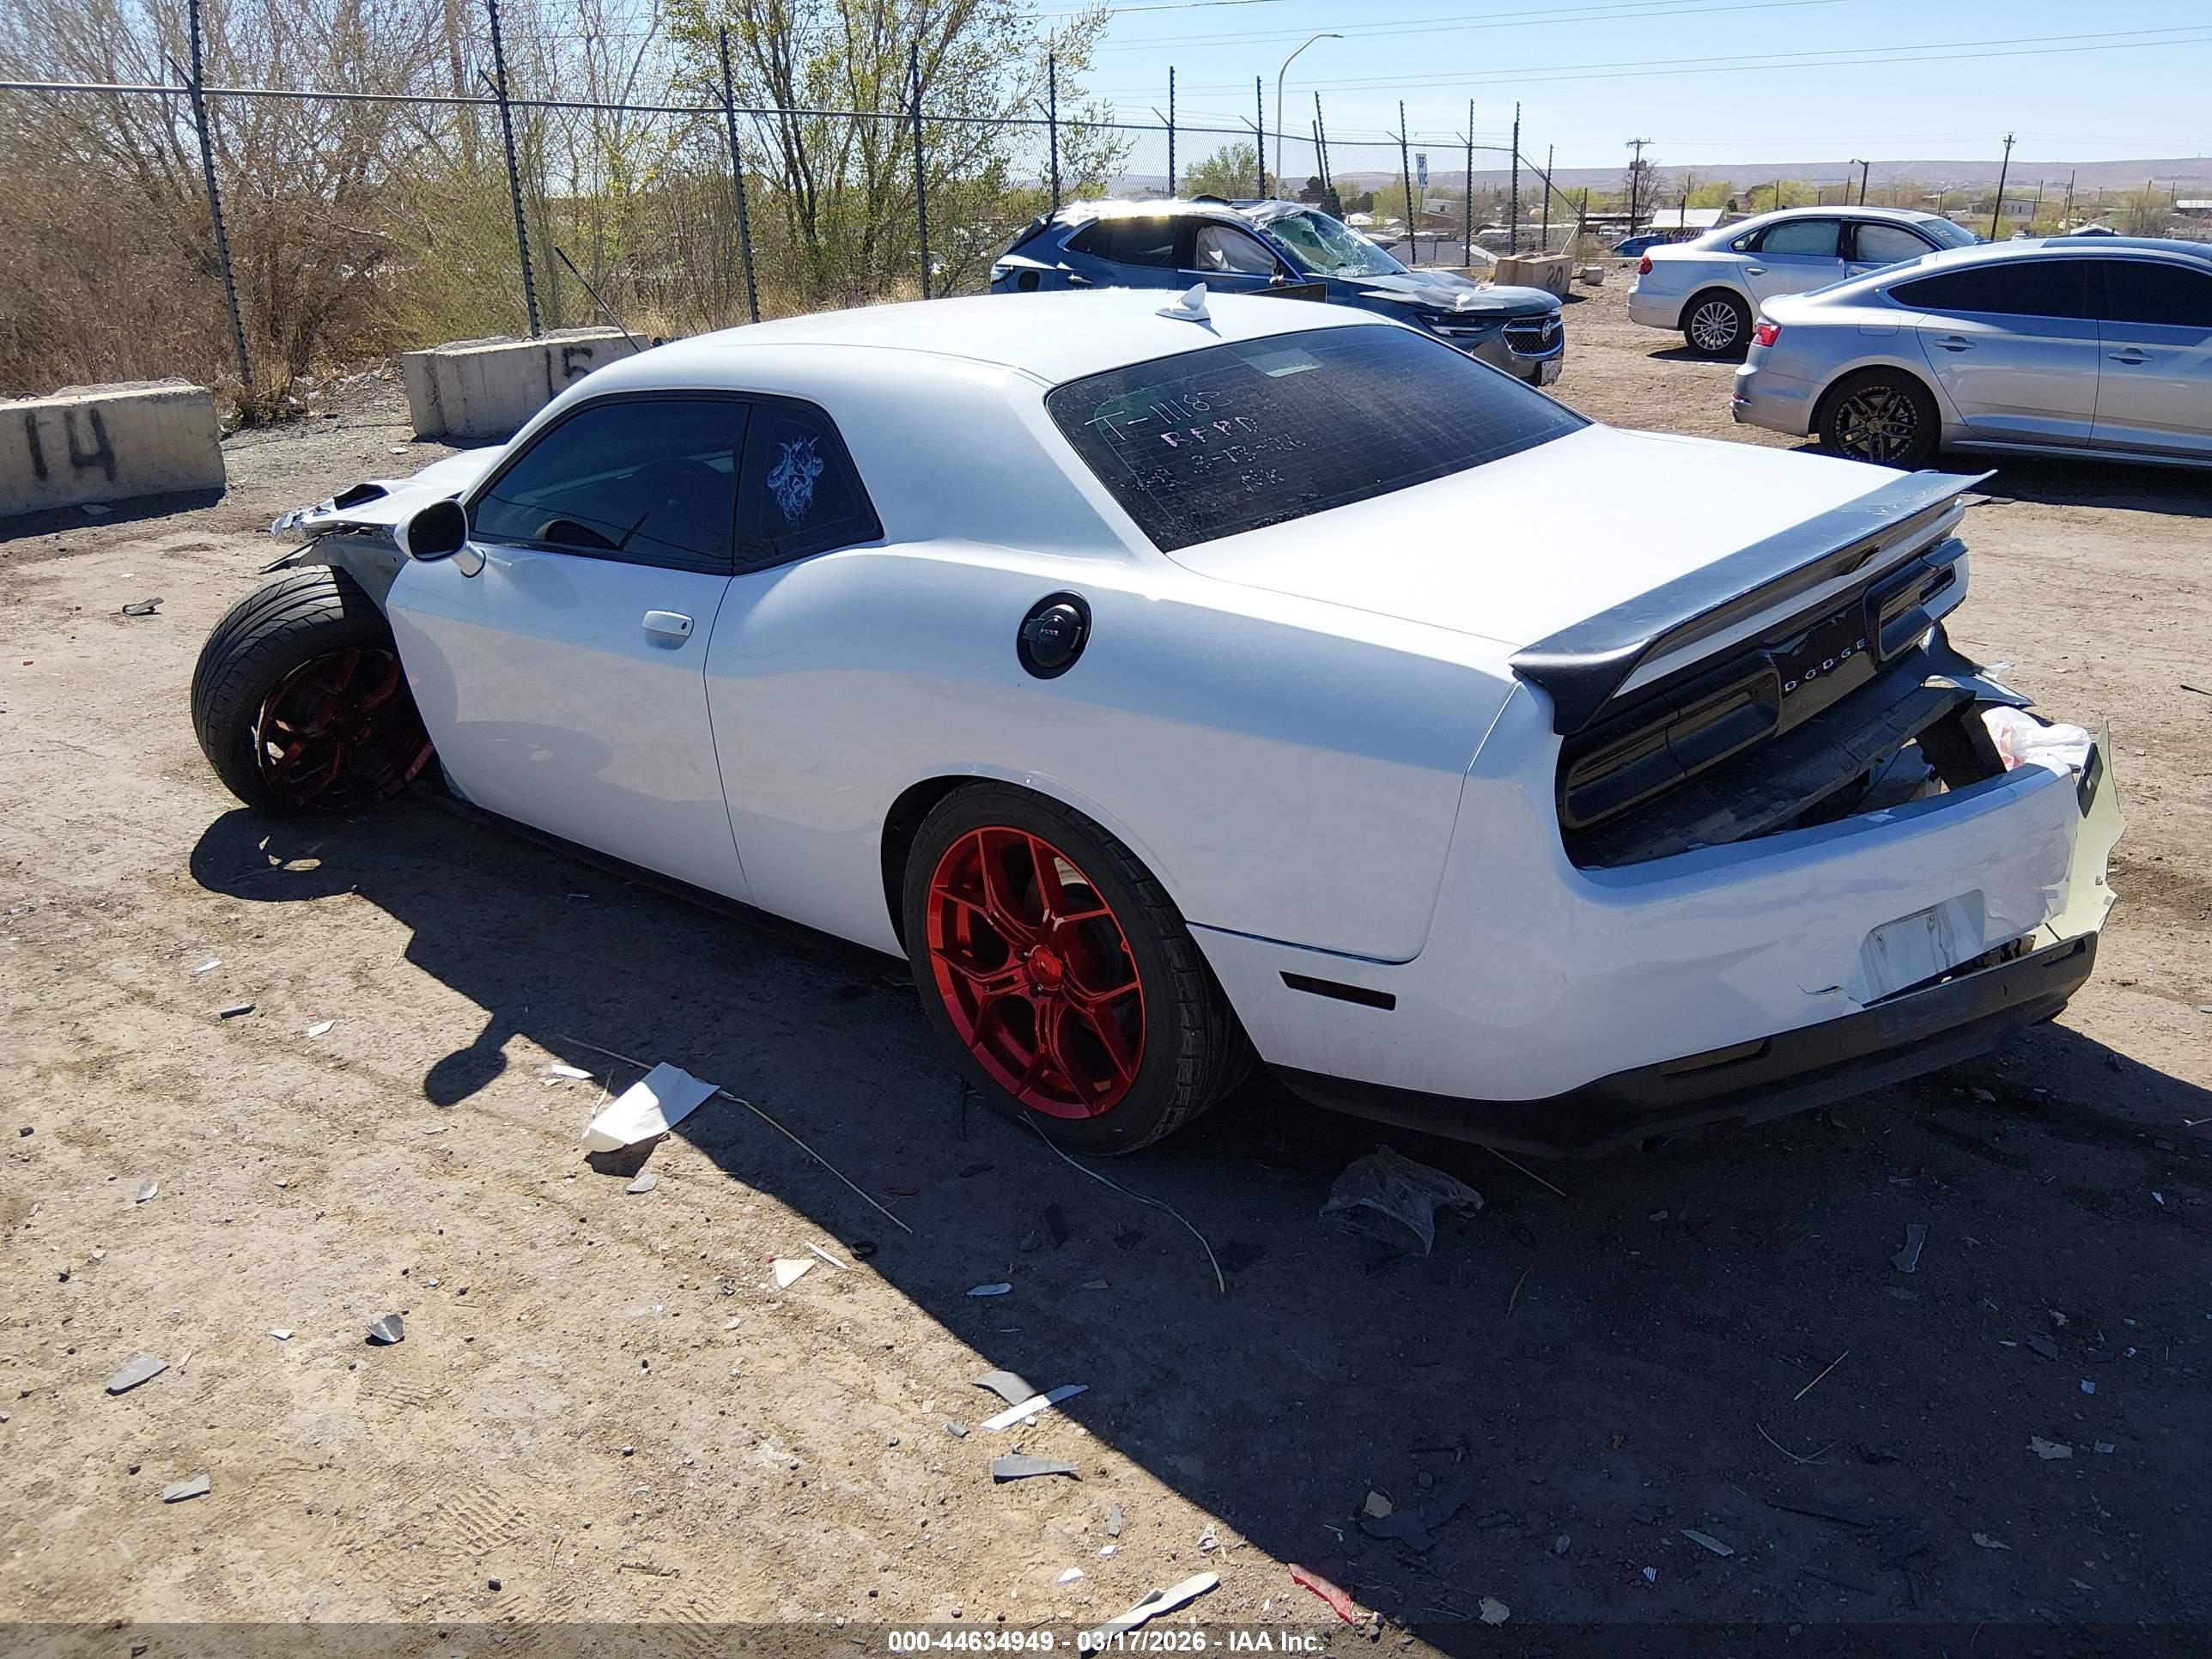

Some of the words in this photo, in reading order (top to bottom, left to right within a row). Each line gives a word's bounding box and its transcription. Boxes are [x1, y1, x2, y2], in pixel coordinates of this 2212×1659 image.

[1547, 264, 1564, 289] 20
[25, 406, 117, 483] 14
[1784, 638, 1868, 693] DODGE
